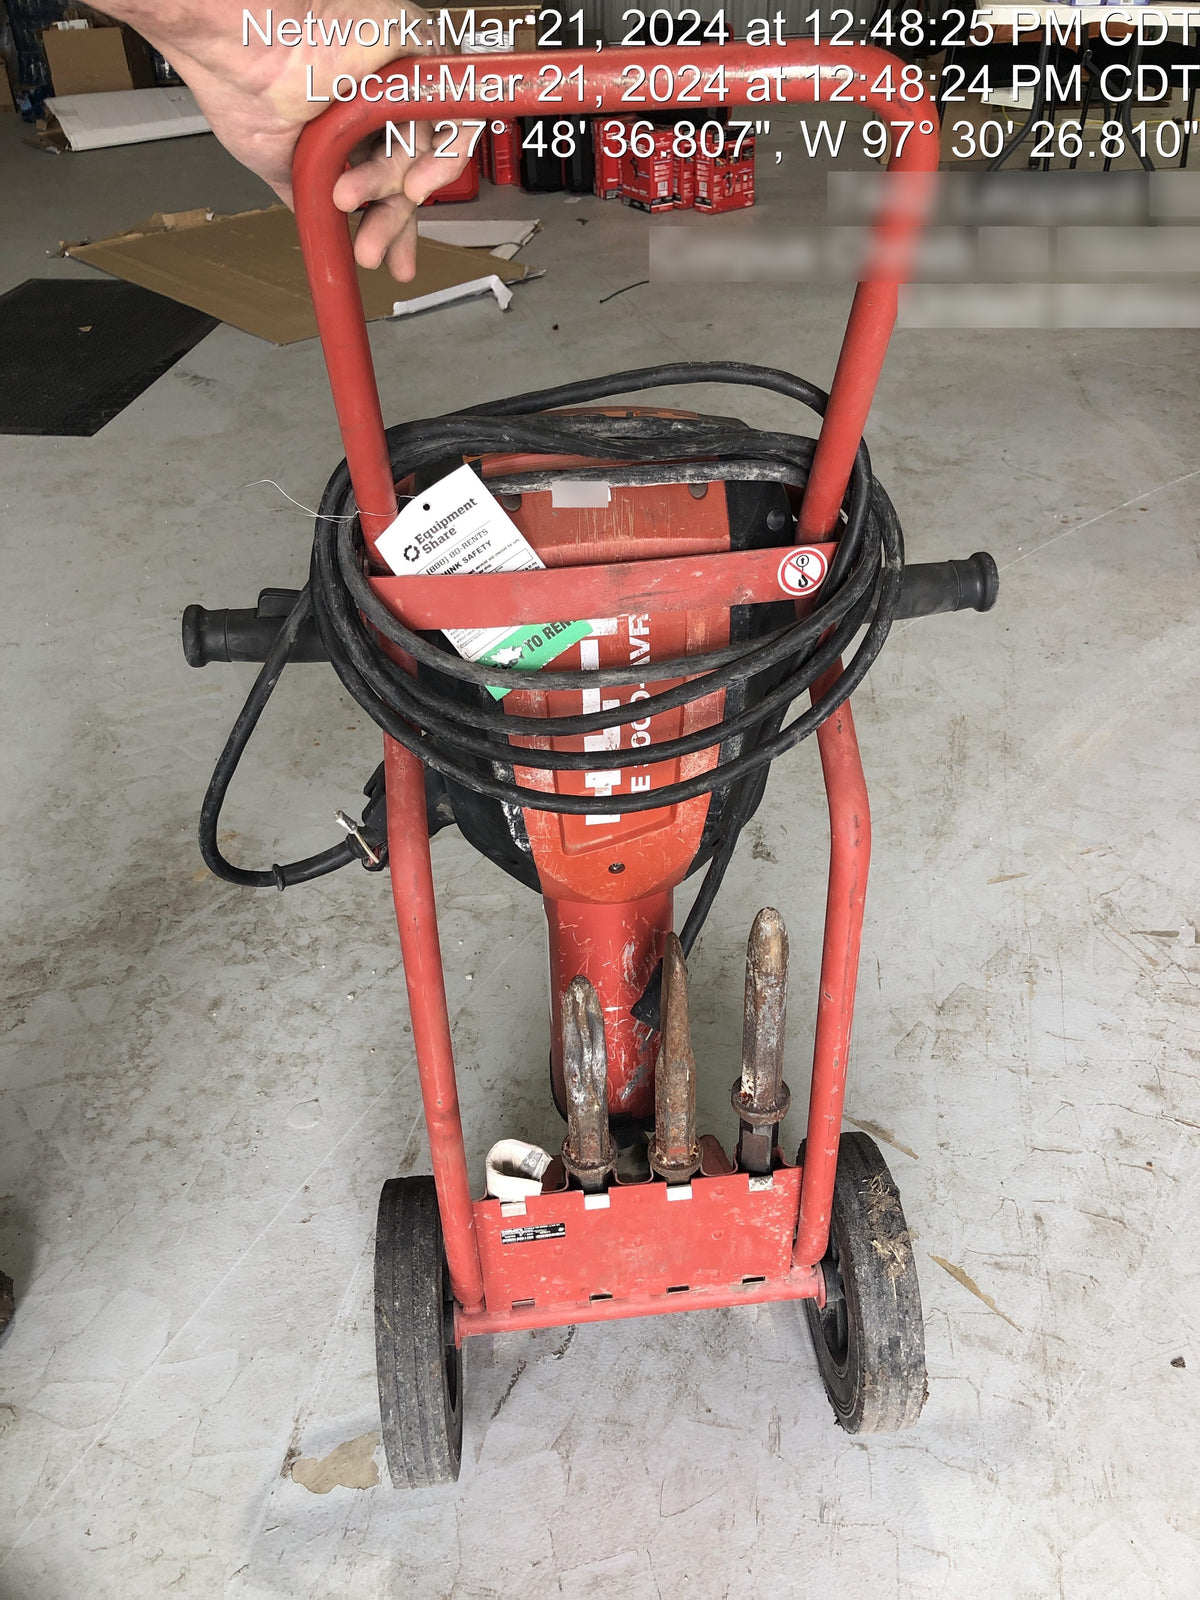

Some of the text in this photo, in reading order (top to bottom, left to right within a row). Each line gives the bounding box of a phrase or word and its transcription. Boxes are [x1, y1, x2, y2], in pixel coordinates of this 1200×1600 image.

[414, 497, 478, 545] Equipment
[421, 527, 458, 555] Share
[440, 561, 463, 576] HINK
[463, 539, 493, 564] SAFETY
[541, 619, 578, 641] REN
